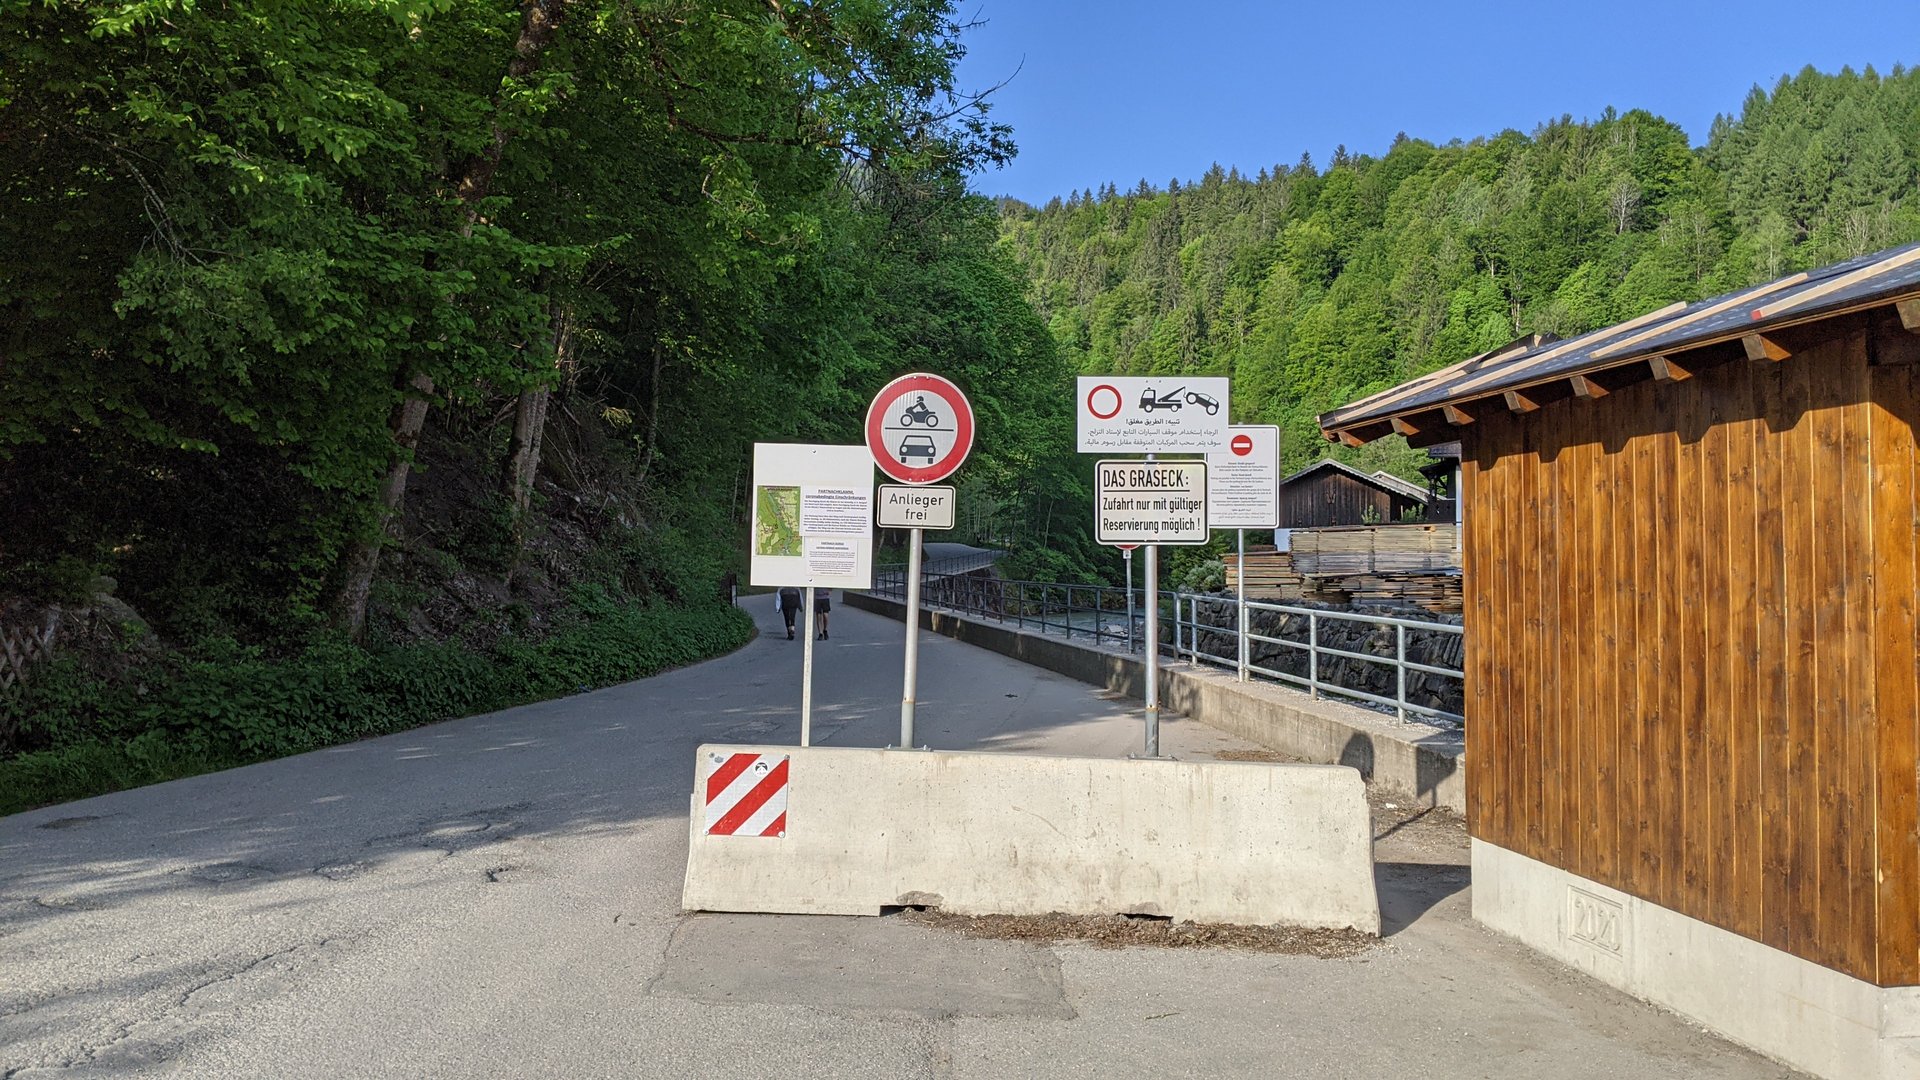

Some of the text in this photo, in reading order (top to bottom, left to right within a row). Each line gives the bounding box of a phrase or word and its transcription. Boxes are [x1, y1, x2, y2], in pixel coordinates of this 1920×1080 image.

[1144, 418, 1164, 427] الطريق
[1161, 429, 1177, 437] موقف
[1103, 469, 1189, 488] DAS GRASECK:
[889, 492, 945, 508] Anlieger
[1103, 497, 1134, 510] Zufahrt
[1136, 500, 1151, 510] nur
[1153, 497, 1167, 510] mit
[1169, 497, 1202, 513] gültiger
[905, 508, 928, 520] frei
[1103, 518, 1159, 534] Reservierung
[1161, 518, 1195, 534] möglich
[1574, 896, 1621, 951] 2020
